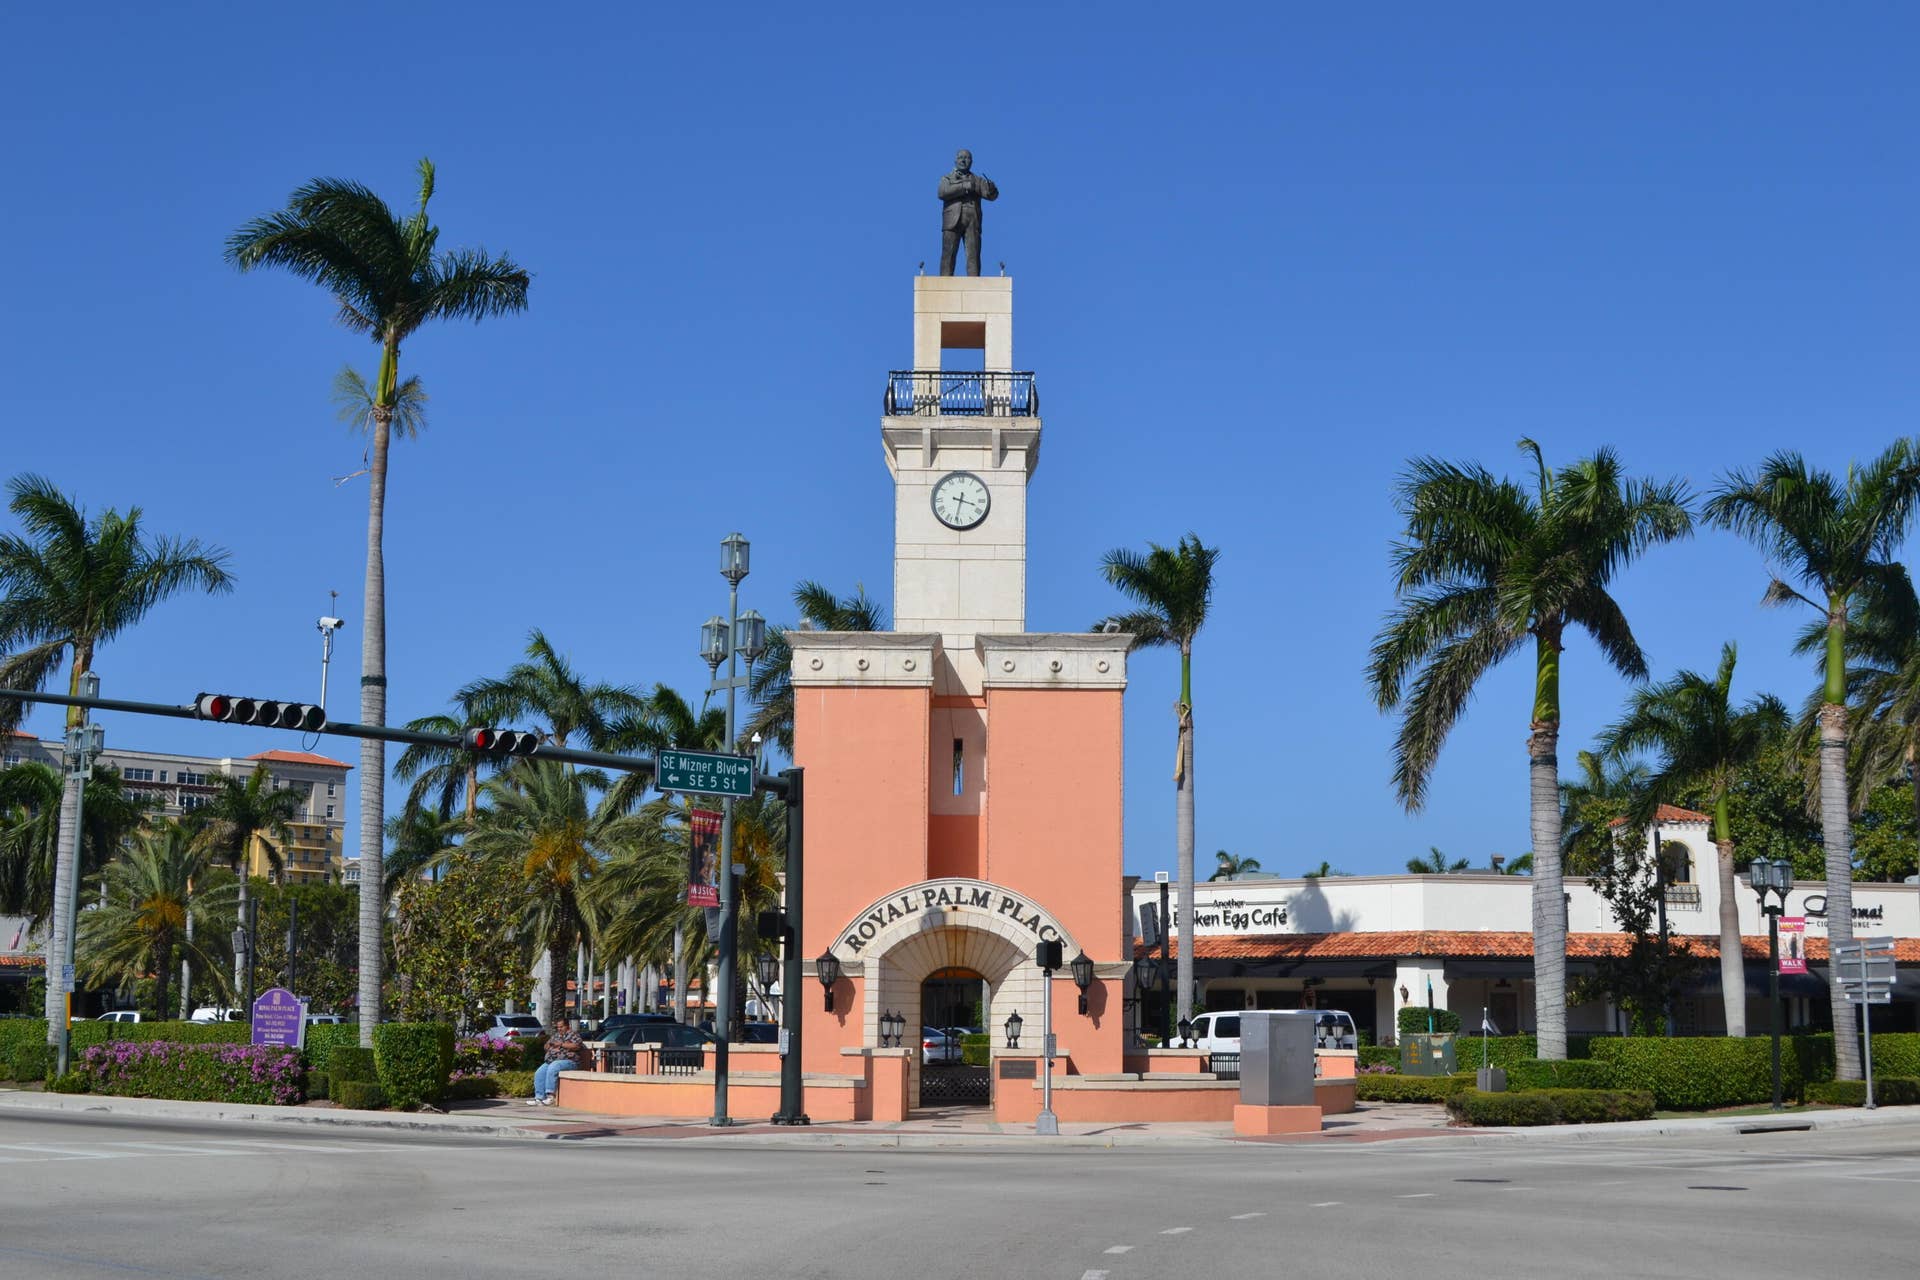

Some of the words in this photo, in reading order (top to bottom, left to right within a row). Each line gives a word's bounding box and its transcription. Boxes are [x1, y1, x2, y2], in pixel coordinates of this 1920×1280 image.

[662, 755, 675, 770] SE
[679, 757, 712, 773] Mizner
[716, 760, 737, 775] Blvd
[689, 774, 704, 787] SE
[710, 776, 718, 788] 5
[723, 777, 737, 790] St
[690, 886, 715, 896] MUSIC
[1212, 898, 1245, 909] Another
[844, 895, 918, 954] ROYAL
[922, 886, 991, 909] PALM
[1222, 910, 1249, 930] Egg
[1251, 907, 1288, 926] Café
[1781, 959, 1803, 968] WALK
